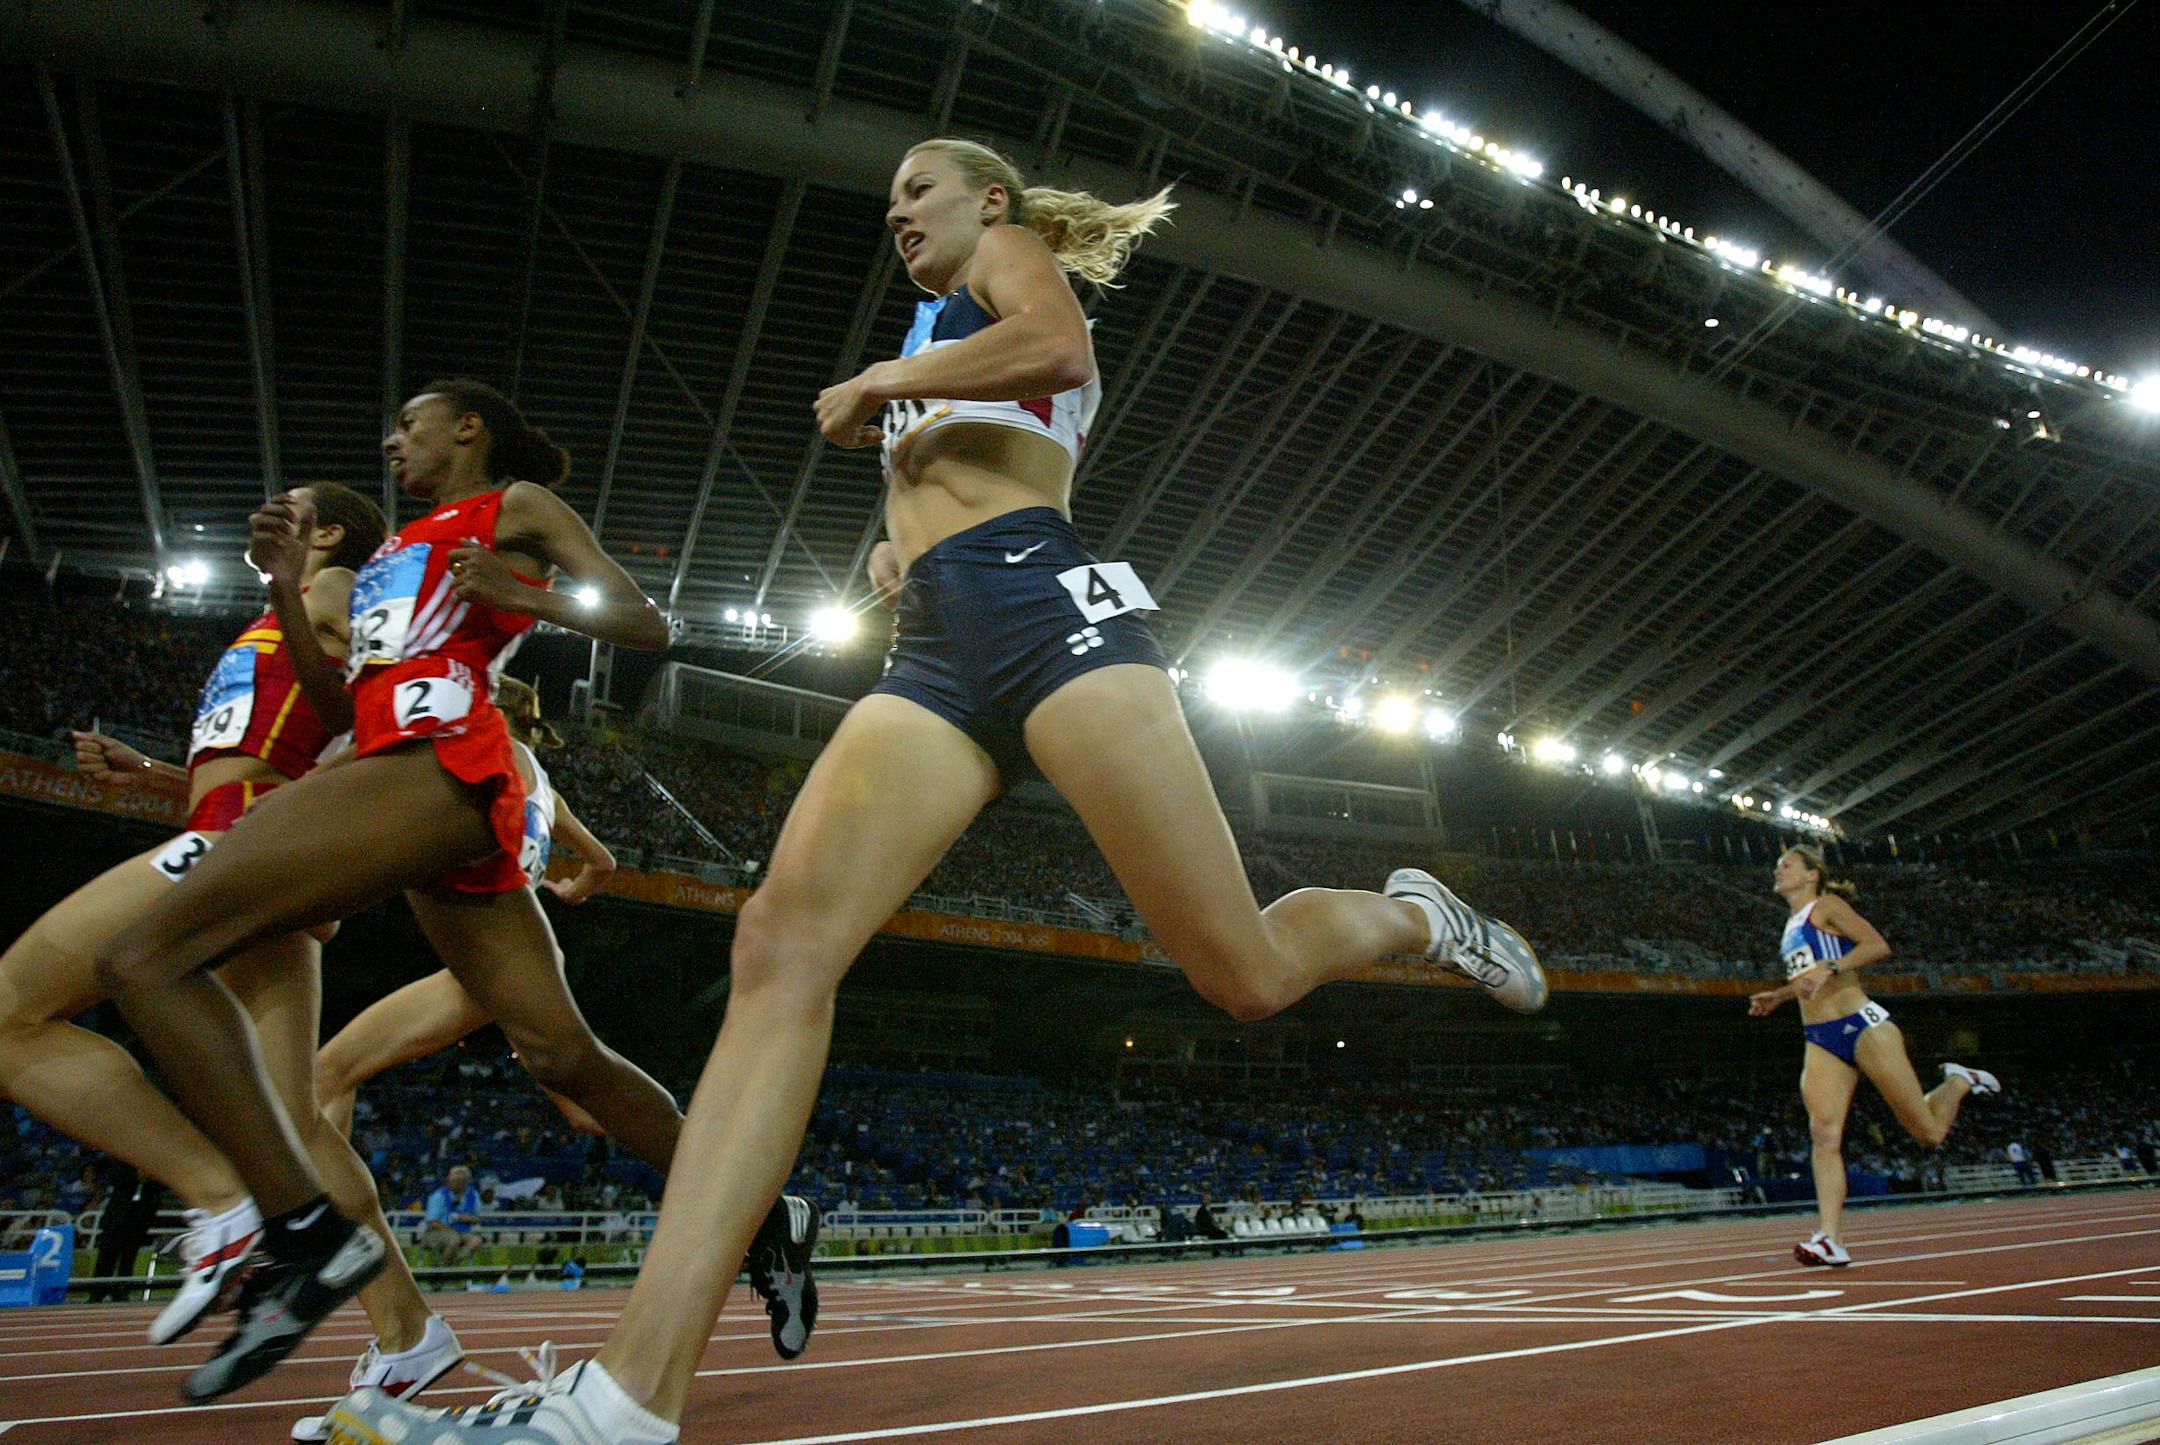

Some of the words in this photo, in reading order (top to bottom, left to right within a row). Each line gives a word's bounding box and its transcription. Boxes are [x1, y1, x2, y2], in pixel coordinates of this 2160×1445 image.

[1087, 567, 1126, 610] 4
[405, 680, 432, 718] 2
[0, 767, 103, 803] ATHENS
[115, 787, 174, 814] 2004
[162, 837, 206, 874] 3
[675, 885, 736, 908] ATHENS
[939, 922, 990, 942] ATHENS
[1864, 1007, 1880, 1024] 8
[38, 1229, 65, 1268] 2
